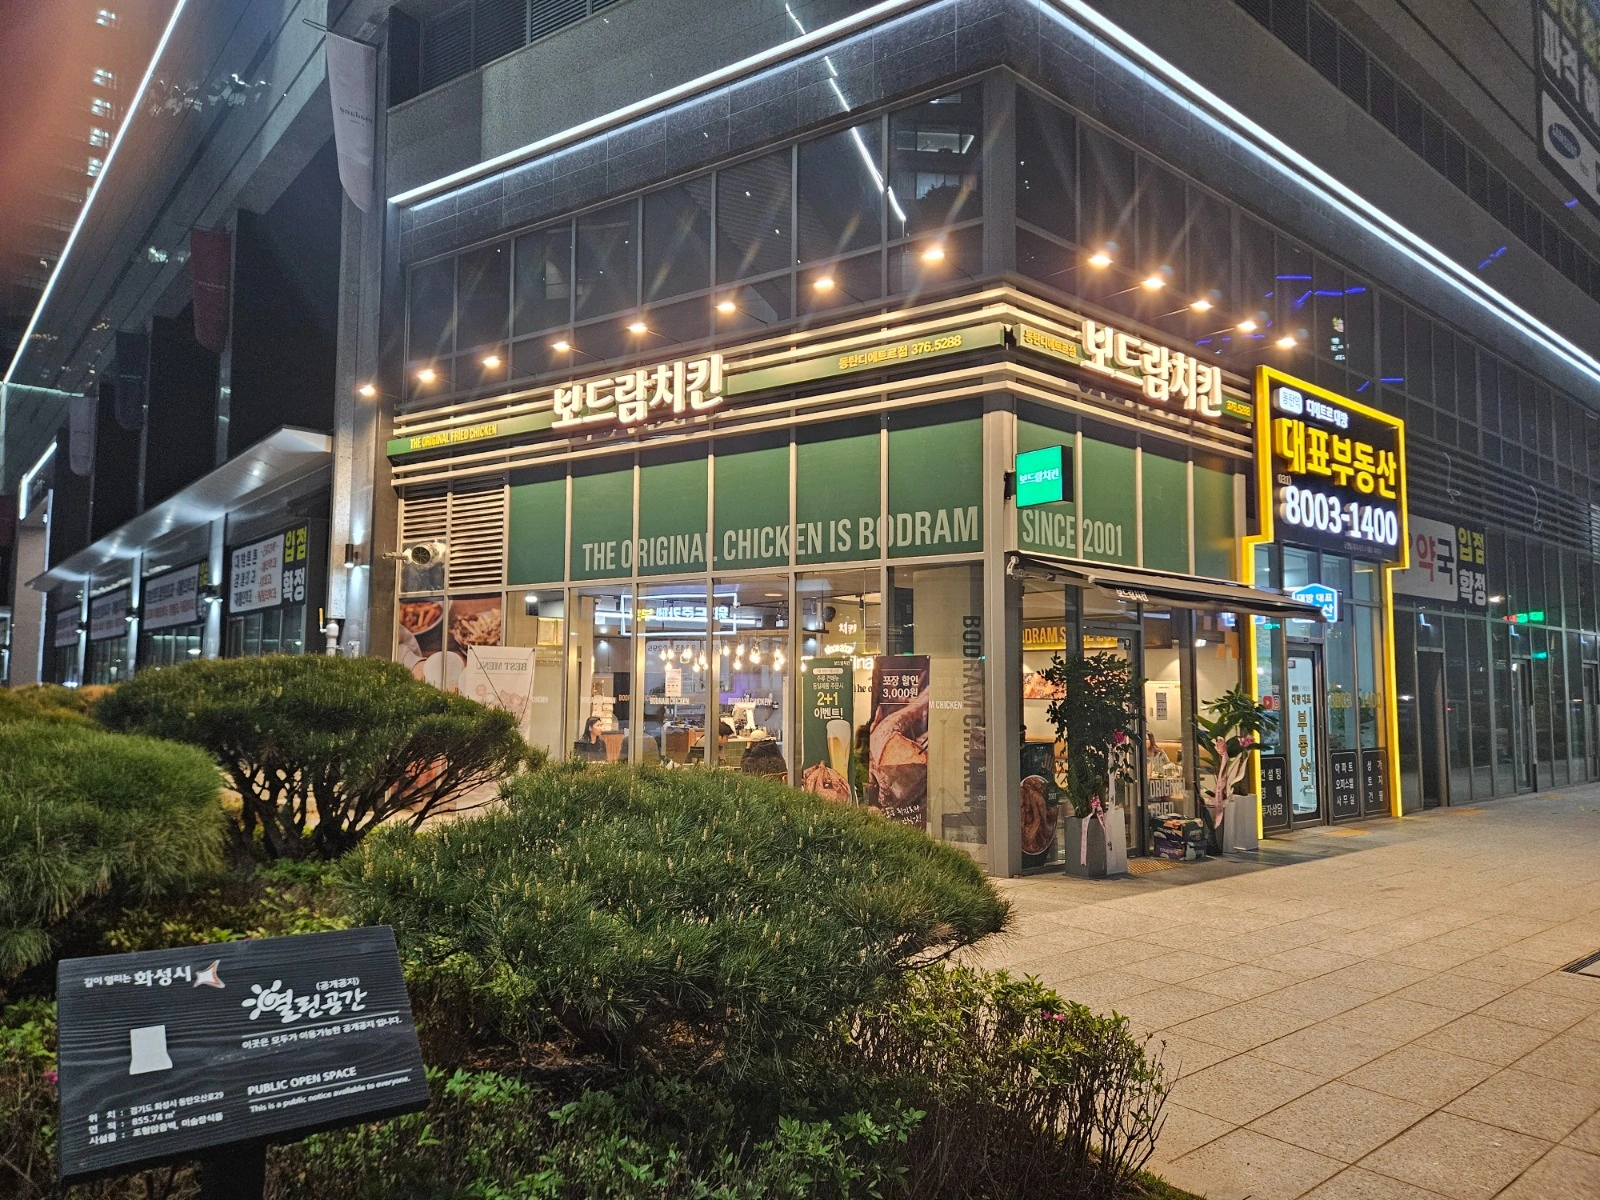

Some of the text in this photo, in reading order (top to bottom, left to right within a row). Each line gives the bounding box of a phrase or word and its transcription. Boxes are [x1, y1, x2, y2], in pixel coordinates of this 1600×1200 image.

[911, 334, 963, 355] 376.5288
[1081, 320, 1222, 416] 보드람치킨
[552, 354, 726, 429] 보드람치킨
[410, 424, 498, 449] THE ORIGINAL FRIED CHICKEN
[1275, 418, 1397, 499] 대표부동산
[1019, 467, 1060, 485] 보드람치킨
[1280, 485, 1398, 546] 8003-1400
[285, 526, 307, 563] 입점
[582, 542, 616, 572] THE
[723, 521, 823, 561] CHICKEN
[829, 518, 852, 553] IS
[1022, 508, 1123, 557] SINCE 2001
[1415, 533, 1460, 576] 약국
[1458, 526, 1486, 565] 입점
[281, 566, 306, 602] 확정
[1459, 568, 1487, 606] 확정
[1316, 594, 1333, 603] 대표
[882, 674, 919, 687] 포장 할인
[882, 687, 919, 699] 3,000원
[669, 697, 689, 705] CHICKEN
[816, 691, 840, 706] 2+1
[936, 700, 963, 710] CHICKEN
[813, 707, 844, 720] 이벤트!
[1298, 710, 1315, 782] 부동산
[1335, 761, 1355, 774] 아파트
[1335, 777, 1355, 790] 오피스텔
[1336, 794, 1357, 807] 사무실
[133, 965, 192, 987] 화성시
[315, 977, 360, 991] (공개공지)
[242, 979, 368, 1024] 열린공간
[241, 1015, 403, 1050] 이곳은 모두가 이용가능한 공개공지 입니다.
[247, 1066, 358, 1096] PUBLIC OPEN SPACE
[129, 1103, 154, 1116] 경기도
[153, 1098, 178, 1111] 화성시
[249, 1104, 268, 1113] This
[268, 1102, 276, 1110] is
[282, 1096, 308, 1109] public
[307, 1091, 333, 1103] notice
[366, 1082, 376, 1091] to
[131, 1112, 164, 1126] 855.74
